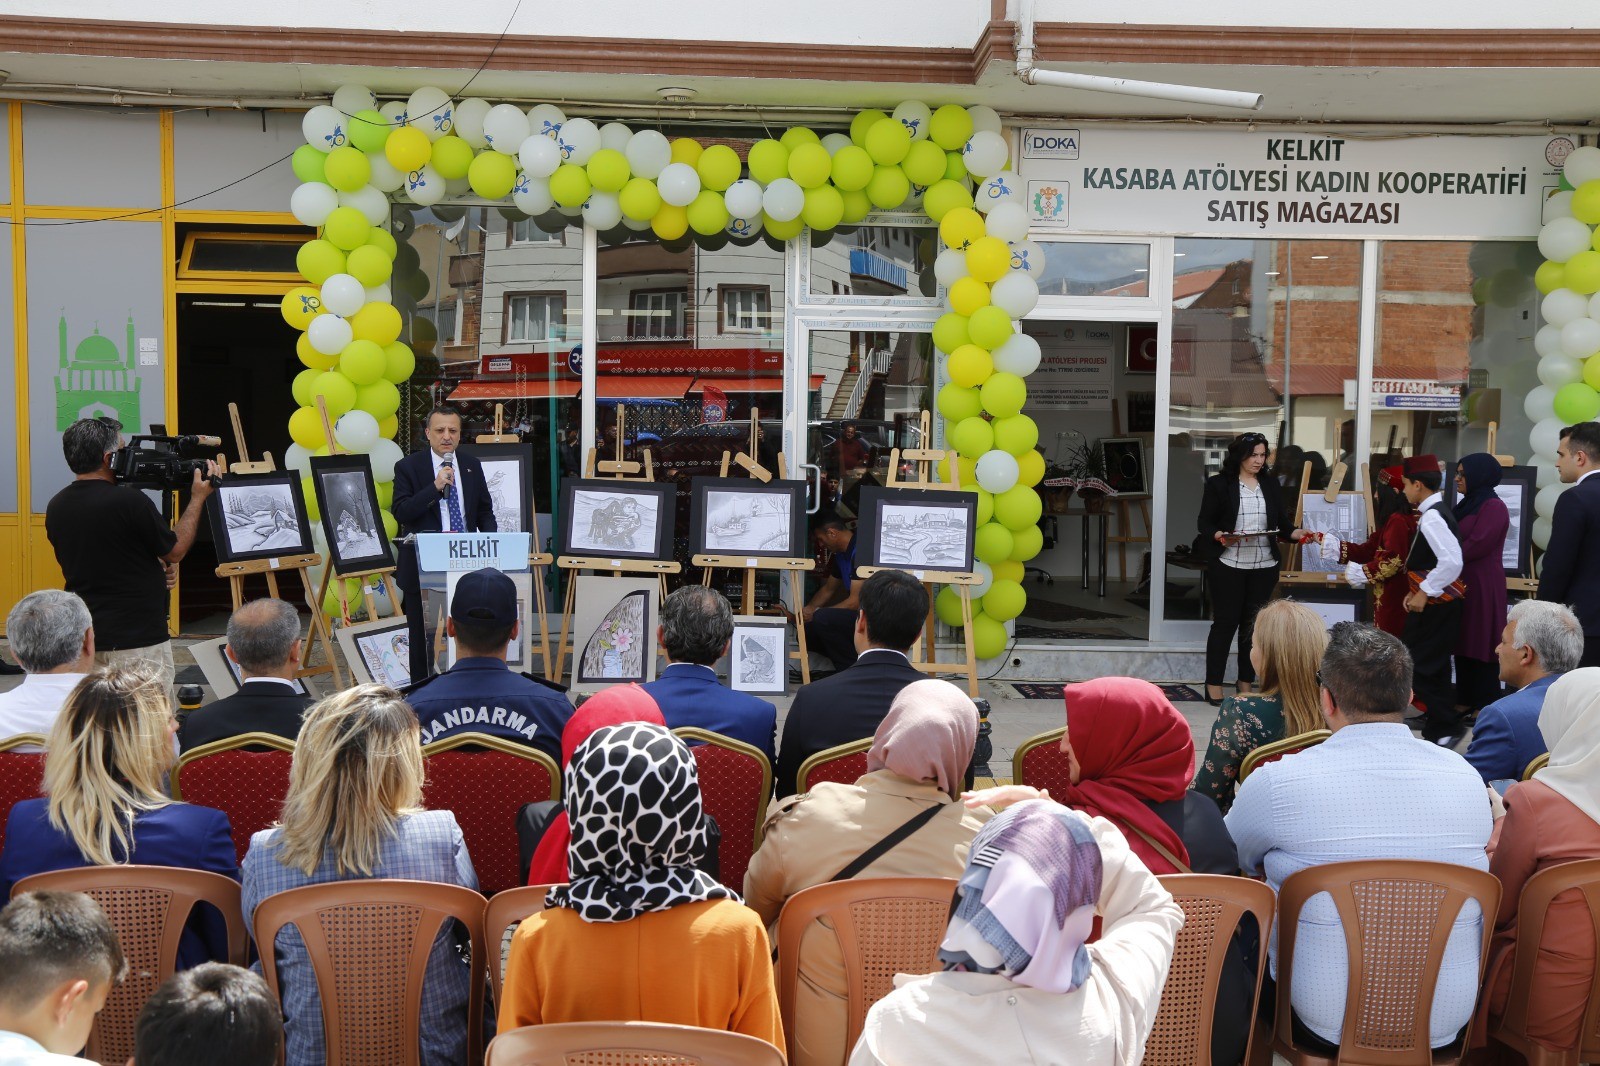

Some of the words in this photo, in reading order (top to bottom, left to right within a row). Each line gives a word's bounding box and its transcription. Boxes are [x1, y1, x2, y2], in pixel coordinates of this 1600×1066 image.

[1033, 137, 1077, 149] DOKA
[1266, 136, 1345, 161] KELKİT
[1083, 167, 1176, 190] KASABA
[1182, 163, 1288, 191] ATÖLYESİ
[1296, 170, 1370, 193] KADIN
[1377, 167, 1527, 195] KOOPERATİFİ
[1207, 200, 1269, 229] SATIŞ
[1277, 195, 1400, 224] MAĞAZASI
[1048, 356, 1078, 364] ATÖLYESİ
[1080, 356, 1107, 365] PROJESİ
[449, 536, 500, 558] KELKİT
[421, 706, 539, 745] JANDARMA
